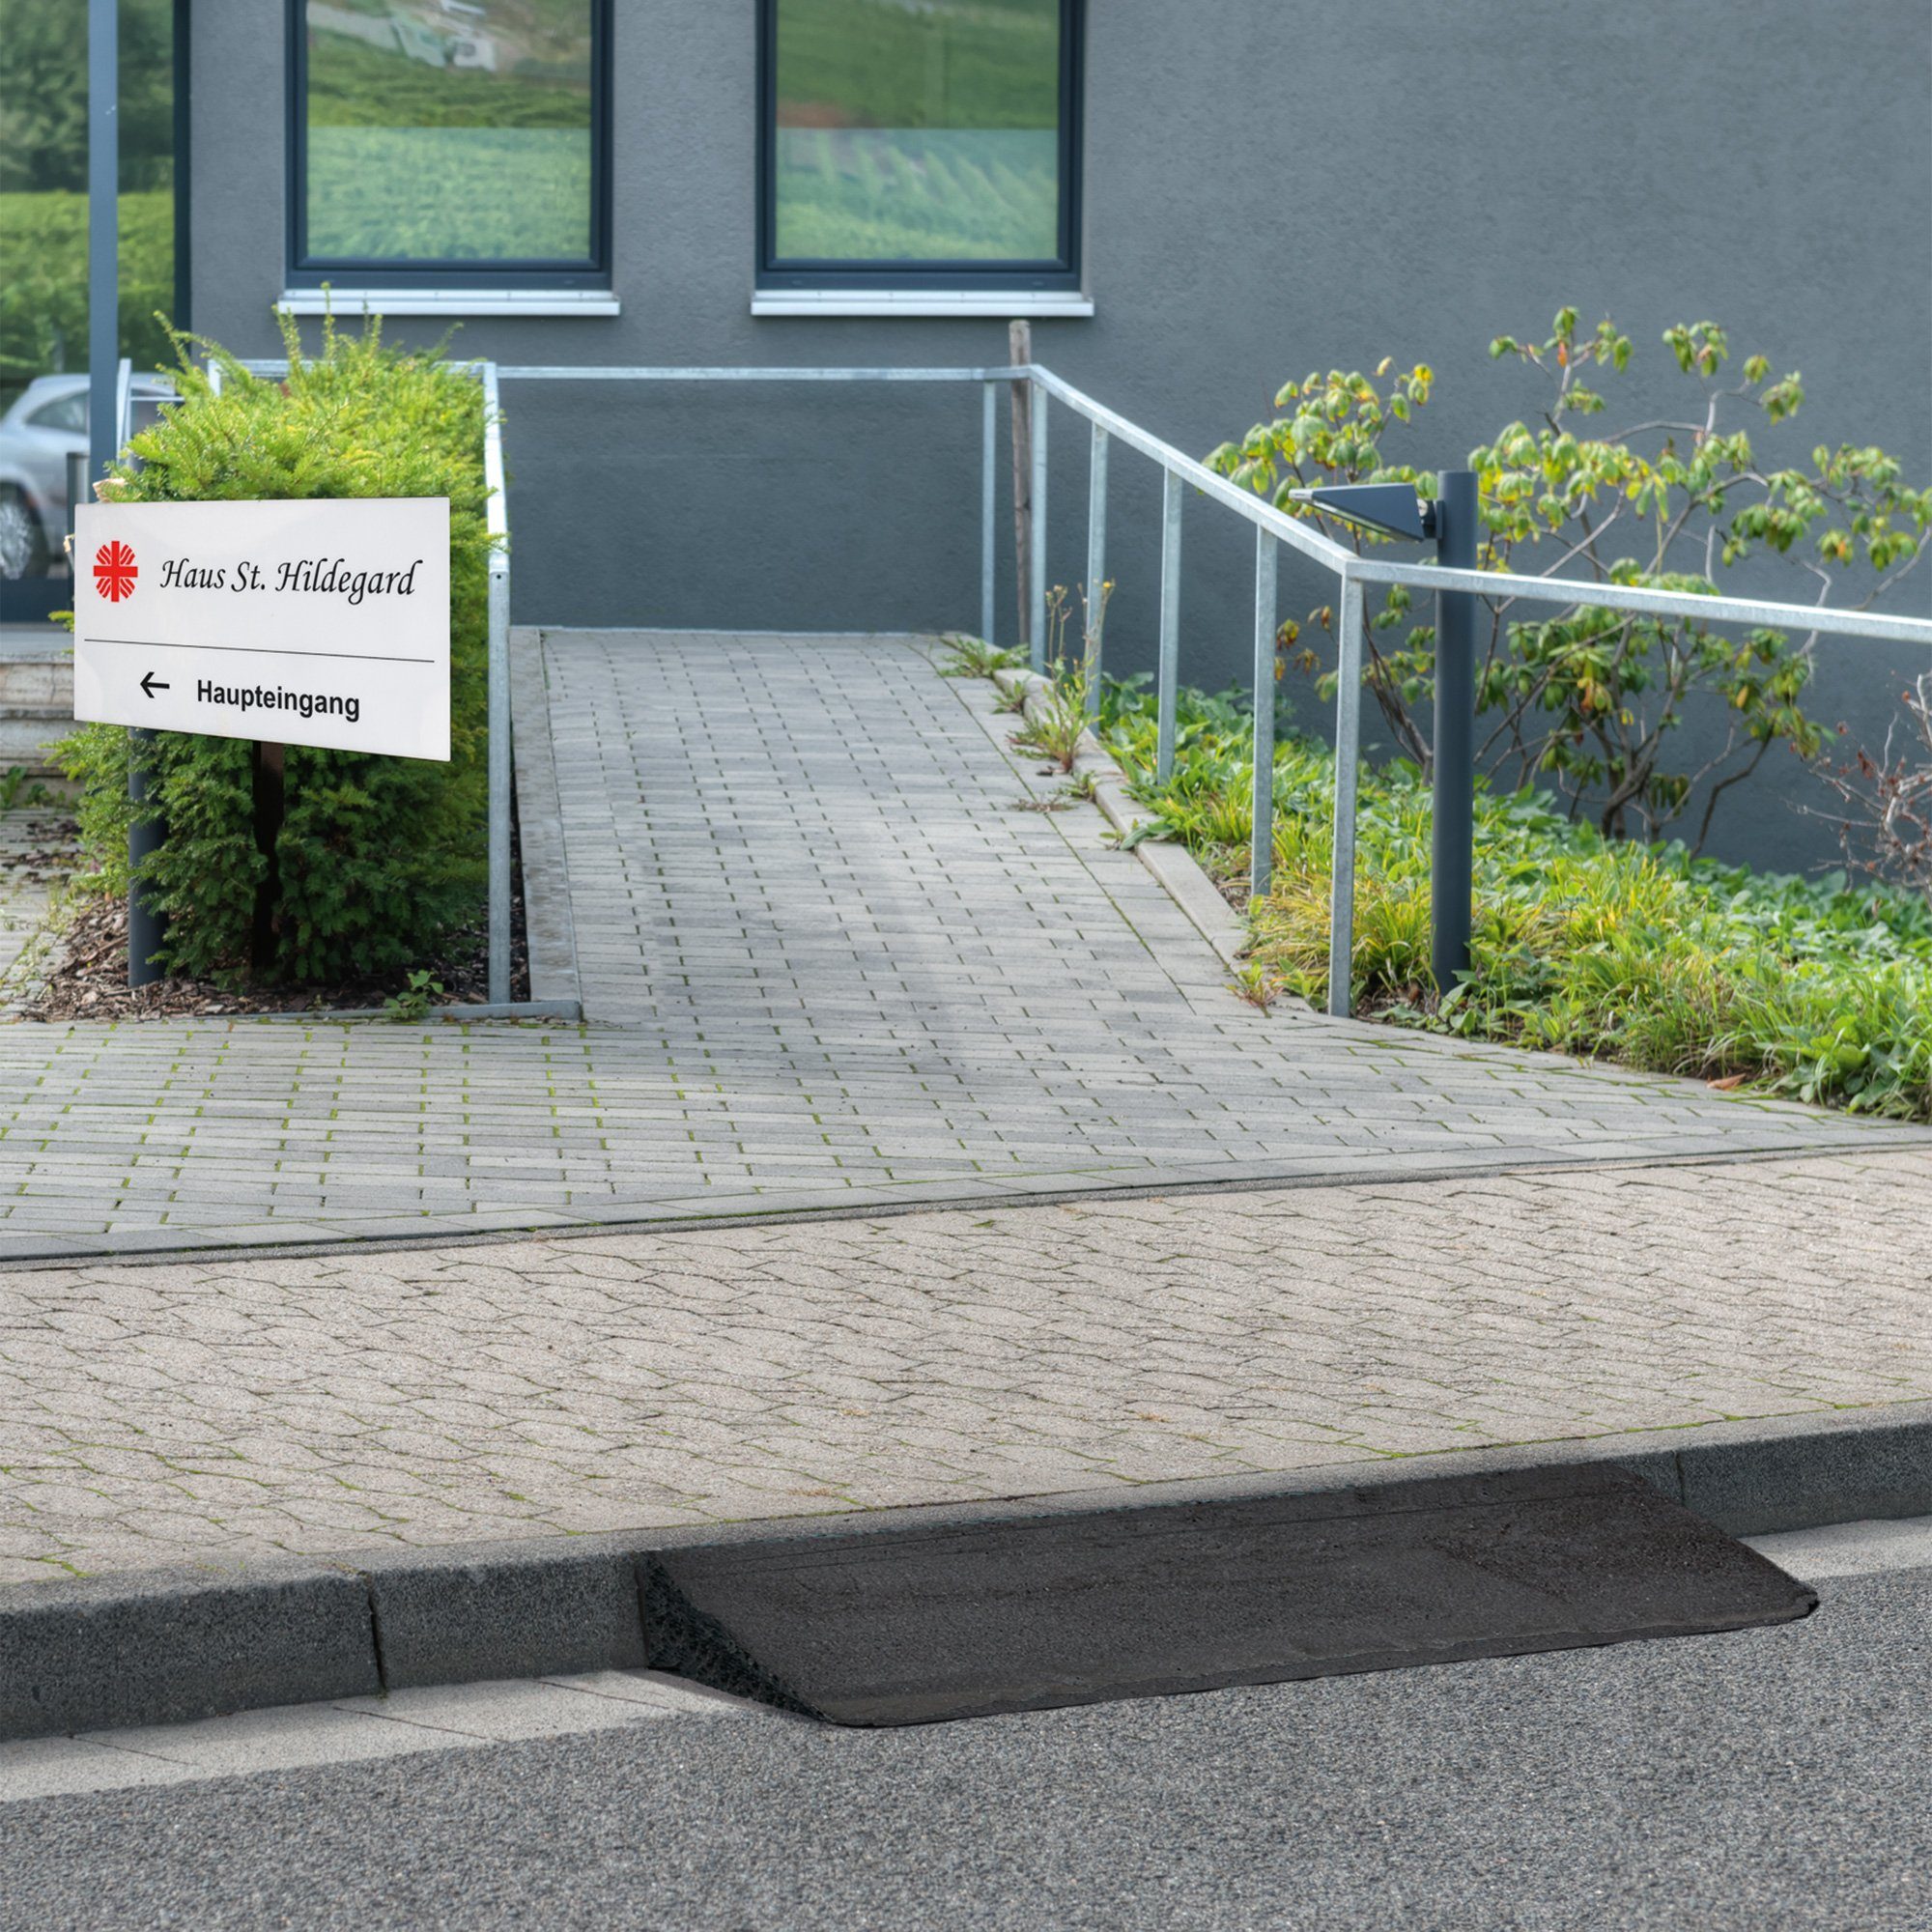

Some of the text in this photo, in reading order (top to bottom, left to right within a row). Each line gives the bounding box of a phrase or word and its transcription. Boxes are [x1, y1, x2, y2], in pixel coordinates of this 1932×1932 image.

[159, 557, 424, 606] Haus St. Hildegard
[197, 679, 360, 723] Haupteingang
